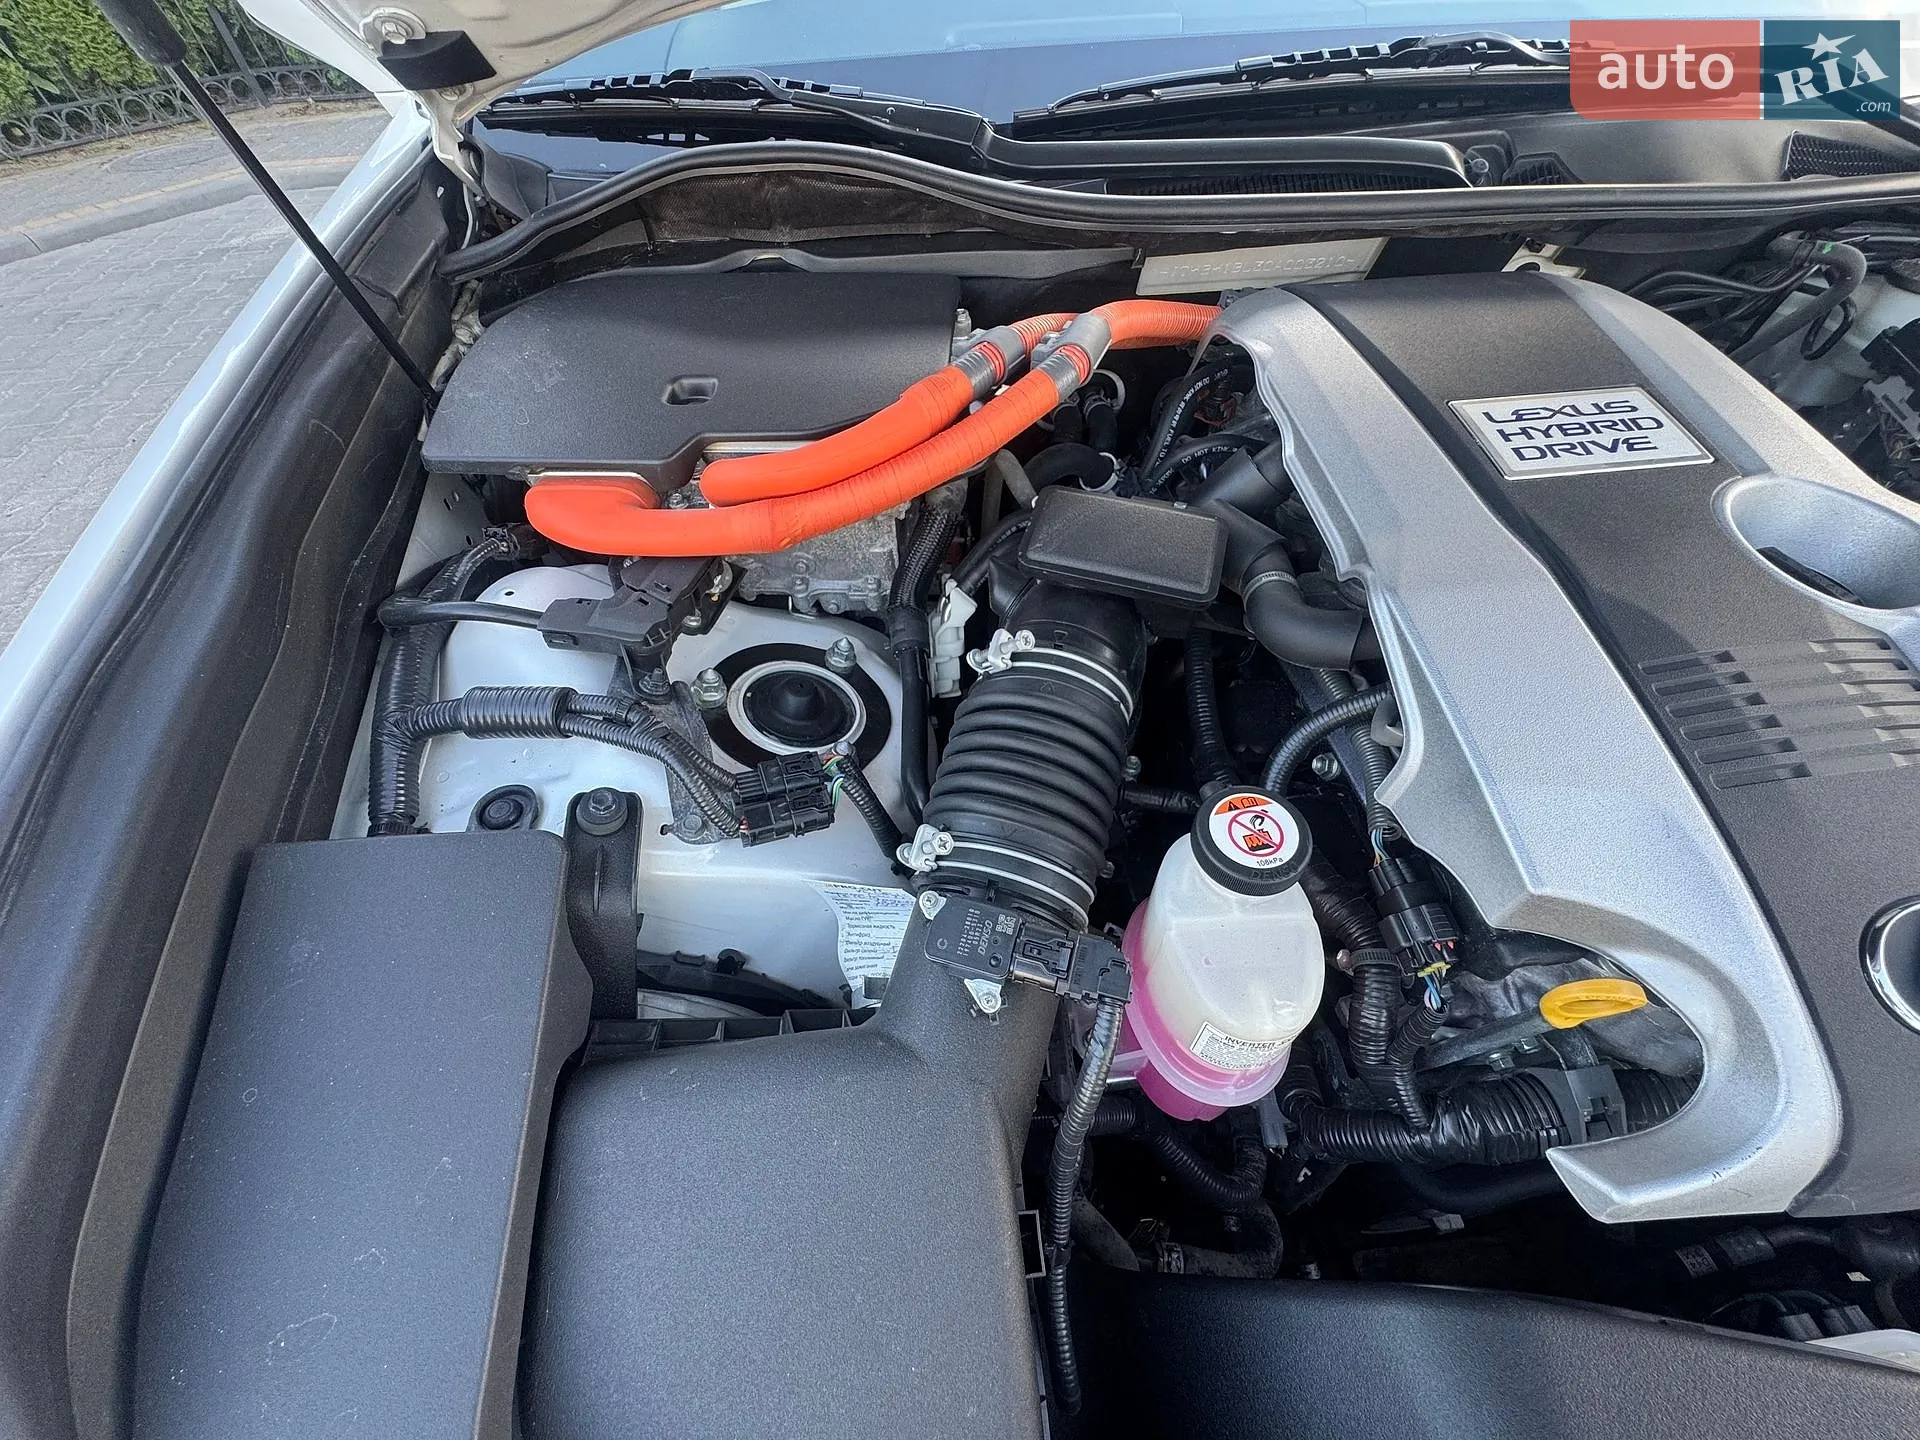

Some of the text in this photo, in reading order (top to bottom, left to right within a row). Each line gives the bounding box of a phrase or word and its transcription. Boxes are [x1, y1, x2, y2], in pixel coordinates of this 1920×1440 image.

[1481, 400, 1639, 423] LEXUS
[1163, 428, 1174, 446] FUEL
[1495, 416, 1664, 442] HYBRID
[1181, 455, 1192, 464] DO
[1194, 447, 1209, 458] NOT
[1510, 436, 1658, 461] DRIVE
[1256, 857, 1284, 867] 108kPa
[977, 919, 993, 955] DENSO
